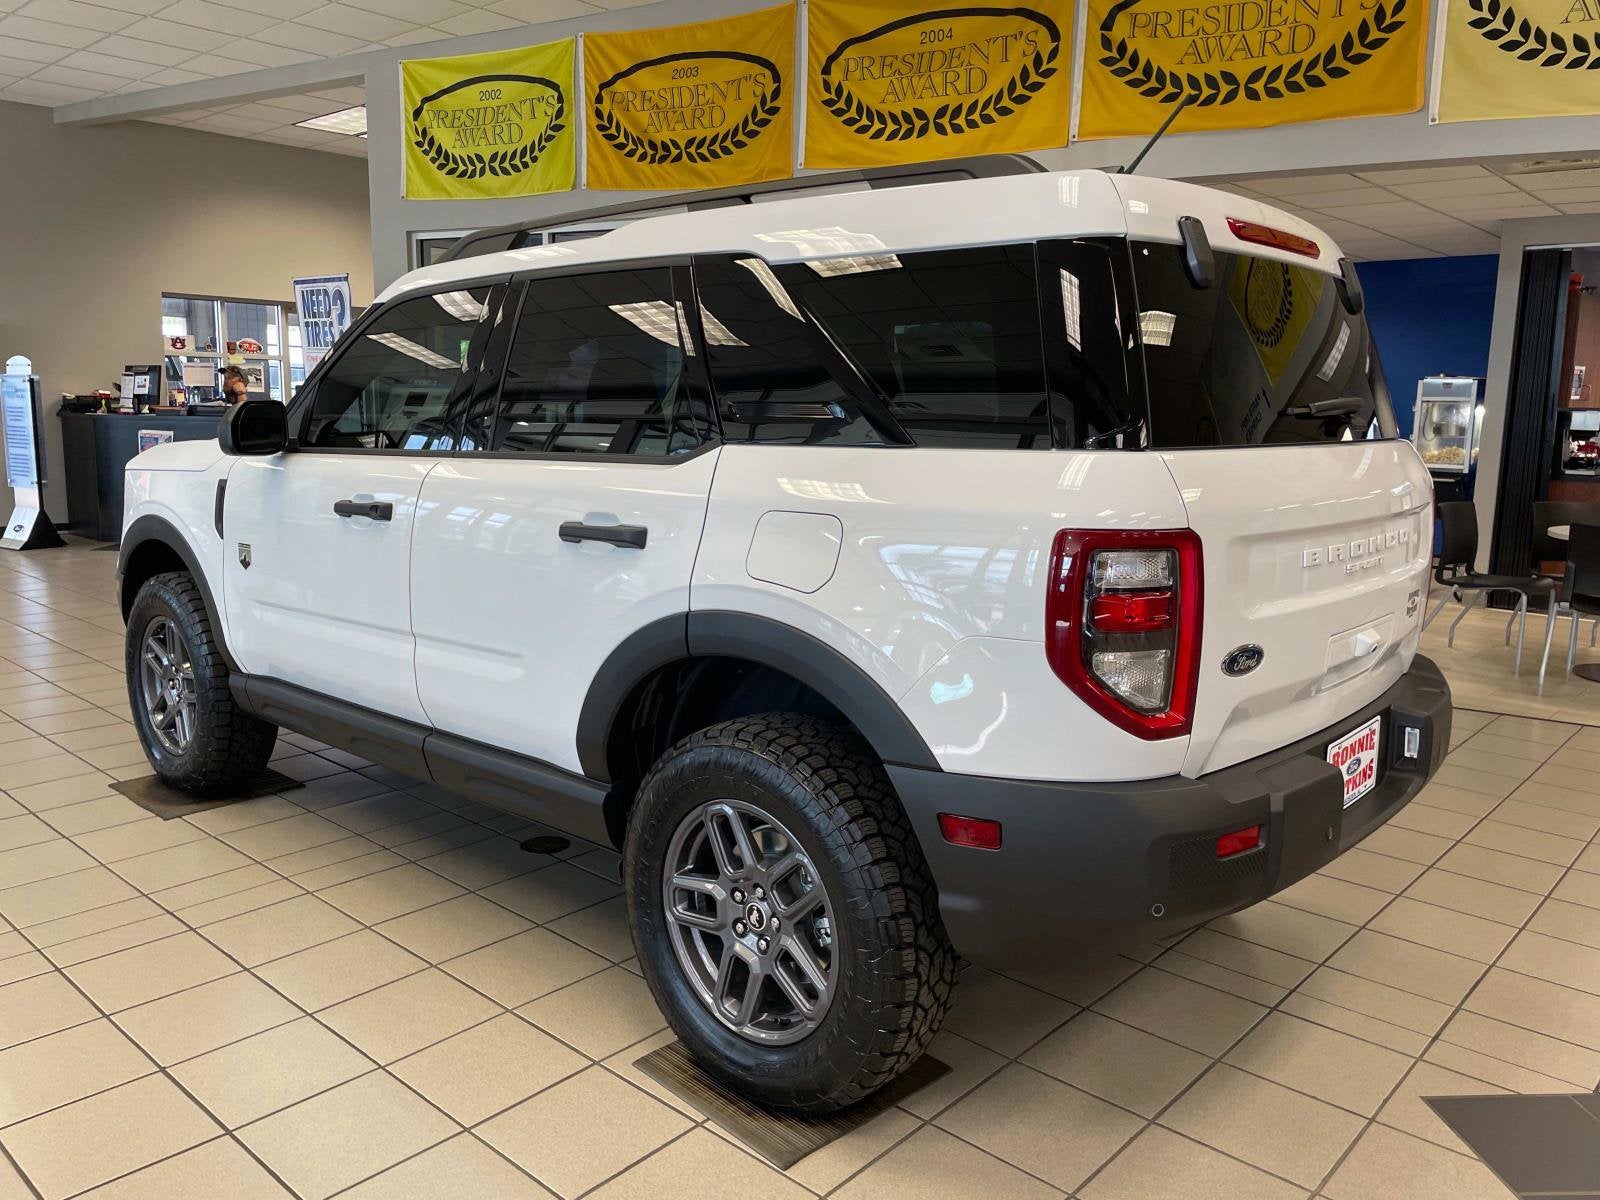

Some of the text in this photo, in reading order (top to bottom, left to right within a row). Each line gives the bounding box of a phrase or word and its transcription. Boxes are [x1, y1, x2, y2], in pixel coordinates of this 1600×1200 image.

[920, 27, 954, 45] 2004
[1127, 0, 1380, 39] PRESIDEN
[842, 30, 1039, 82] PRESIDENT'S
[1176, 23, 1316, 65] AWARD
[672, 66, 699, 80] 2003
[880, 66, 988, 104] AWARD
[479, 89, 502, 102] 2002
[609, 72, 766, 113] PRESIDENT'S
[425, 95, 556, 130] PRESIDENT'S
[642, 104, 726, 134] AWARD
[452, 122, 524, 149] AWARD
[301, 288, 332, 319] NEED
[304, 320, 335, 348] TIRES
[1302, 529, 1410, 568] BRONCO
[1332, 729, 1377, 769] RONNIE
